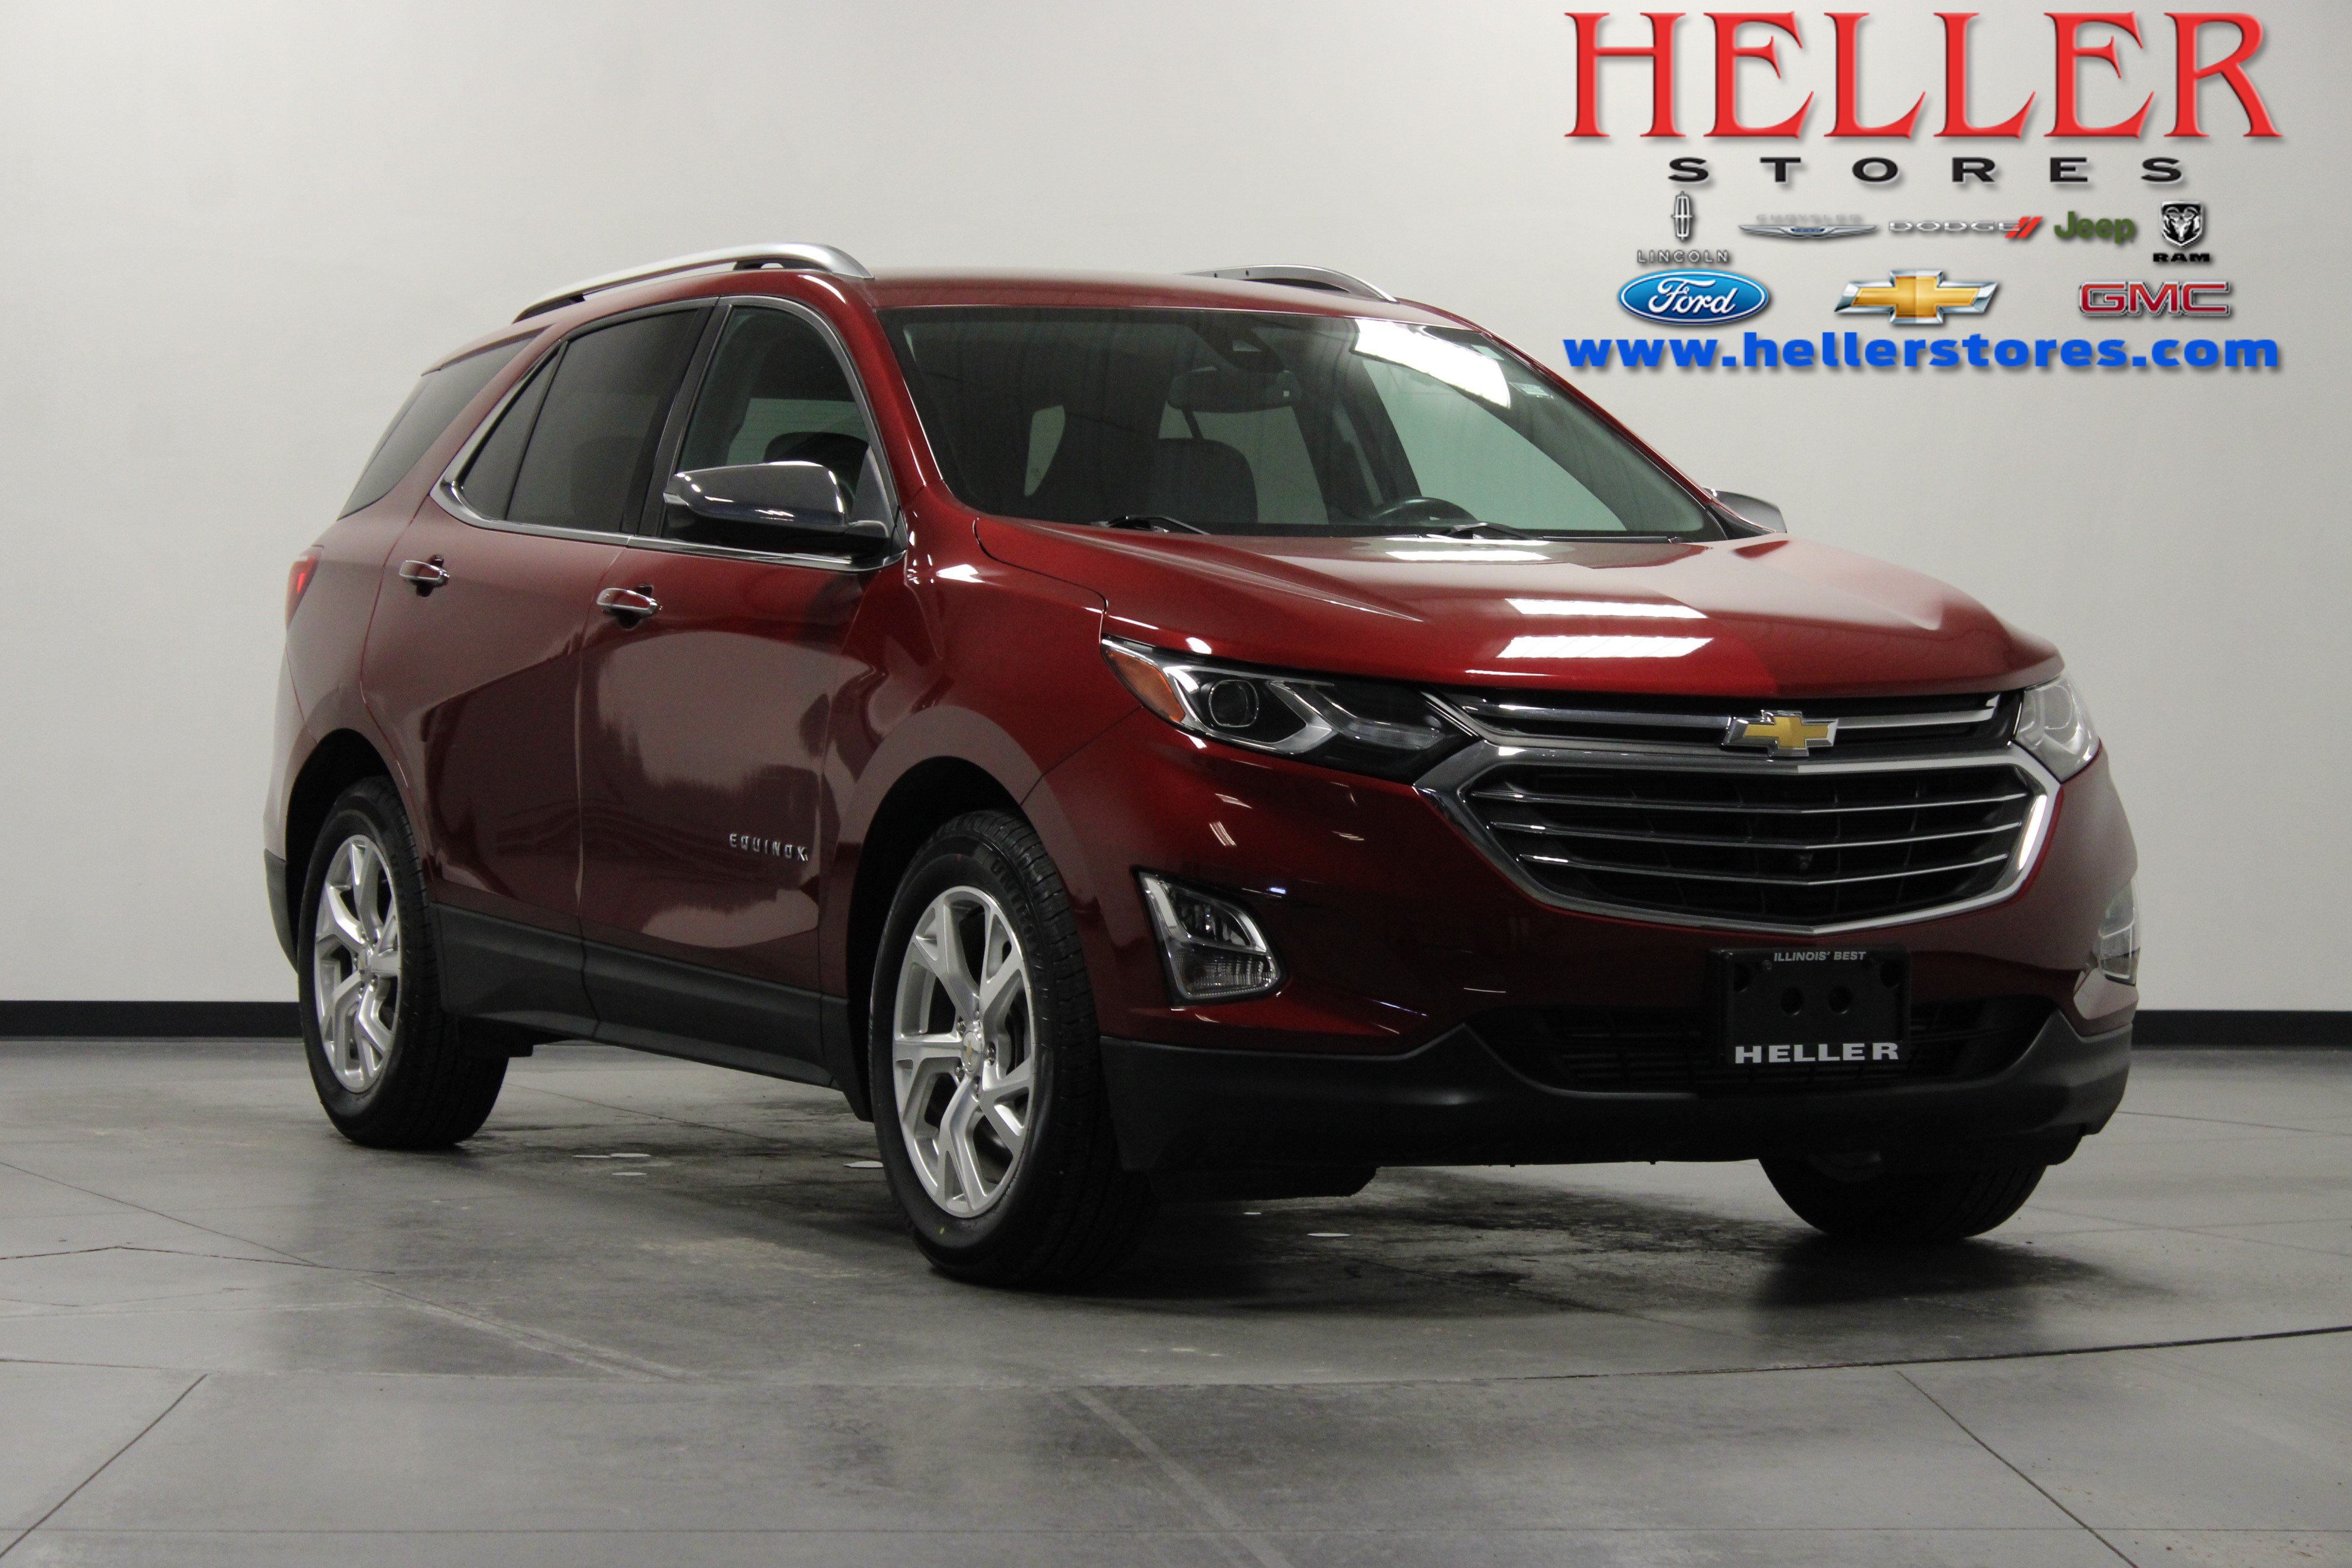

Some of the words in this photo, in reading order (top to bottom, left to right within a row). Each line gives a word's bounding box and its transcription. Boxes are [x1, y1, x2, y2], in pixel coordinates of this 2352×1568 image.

[729, 833, 808, 861] EQUINOX
[1834, 951, 1867, 961] BEST
[1735, 1043, 1899, 1064] HELLER
